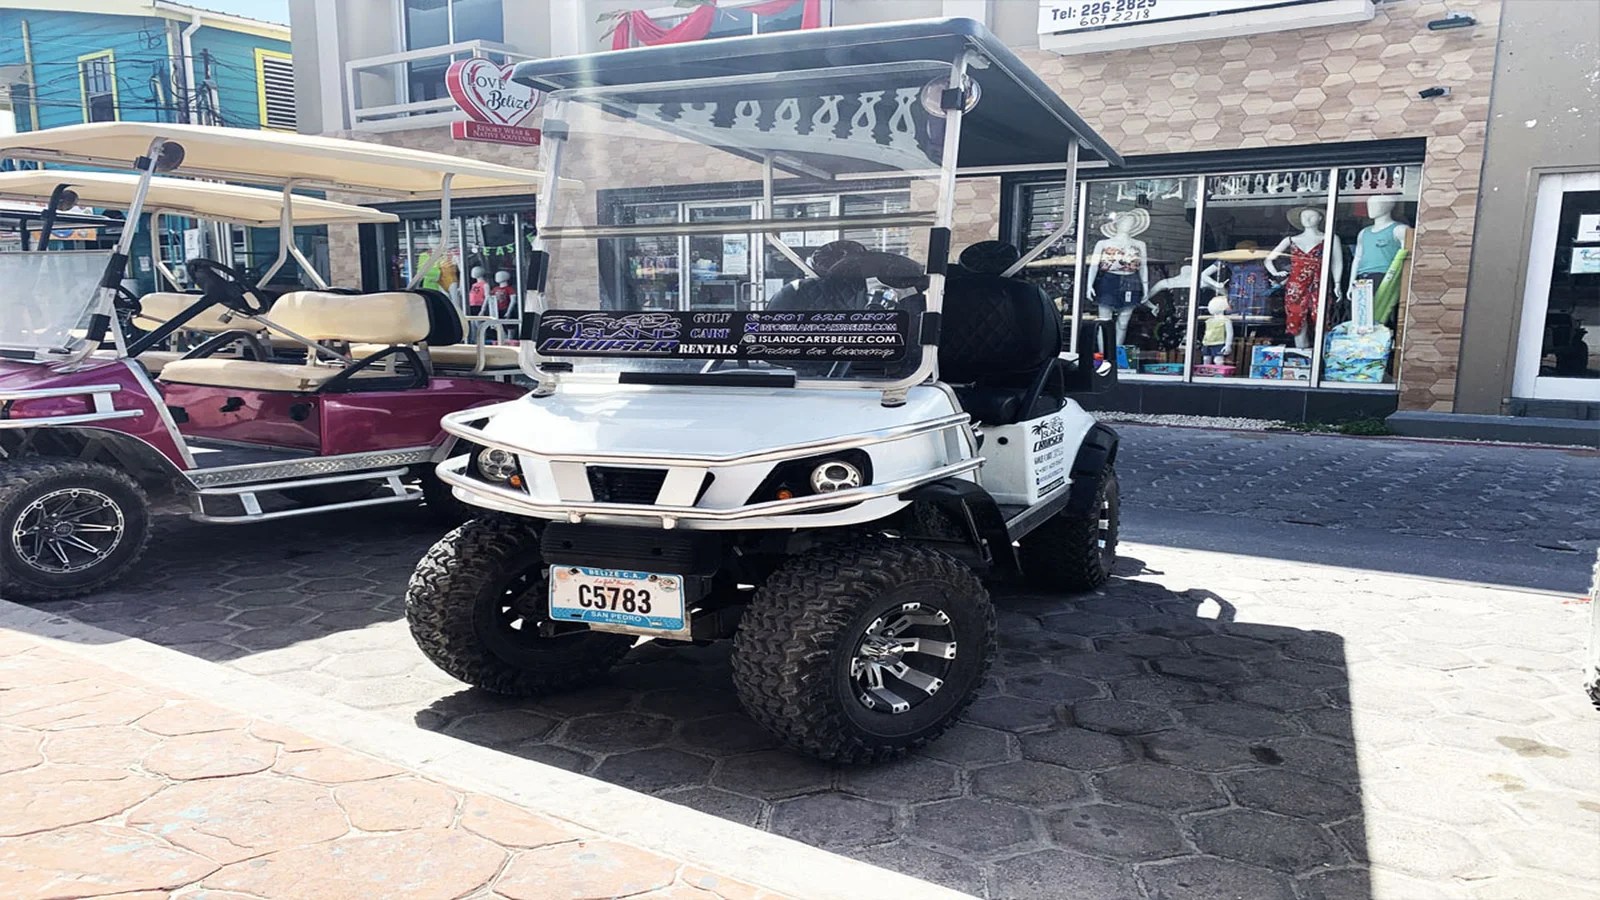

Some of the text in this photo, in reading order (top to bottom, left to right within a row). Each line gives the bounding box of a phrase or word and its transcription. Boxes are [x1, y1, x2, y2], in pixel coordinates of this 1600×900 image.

[1051, 7, 1077, 20] Tel:
[1080, 9, 1150, 26] 607 2218
[467, 73, 506, 90] LOVE
[487, 90, 531, 110] Belize
[758, 335, 896, 344] ISLANDCARTSBELIZE.COM
[678, 343, 739, 354] RENTALS
[588, 568, 620, 578] BELIZE
[578, 584, 651, 614] C5783
[611, 614, 641, 622] PEDRO
